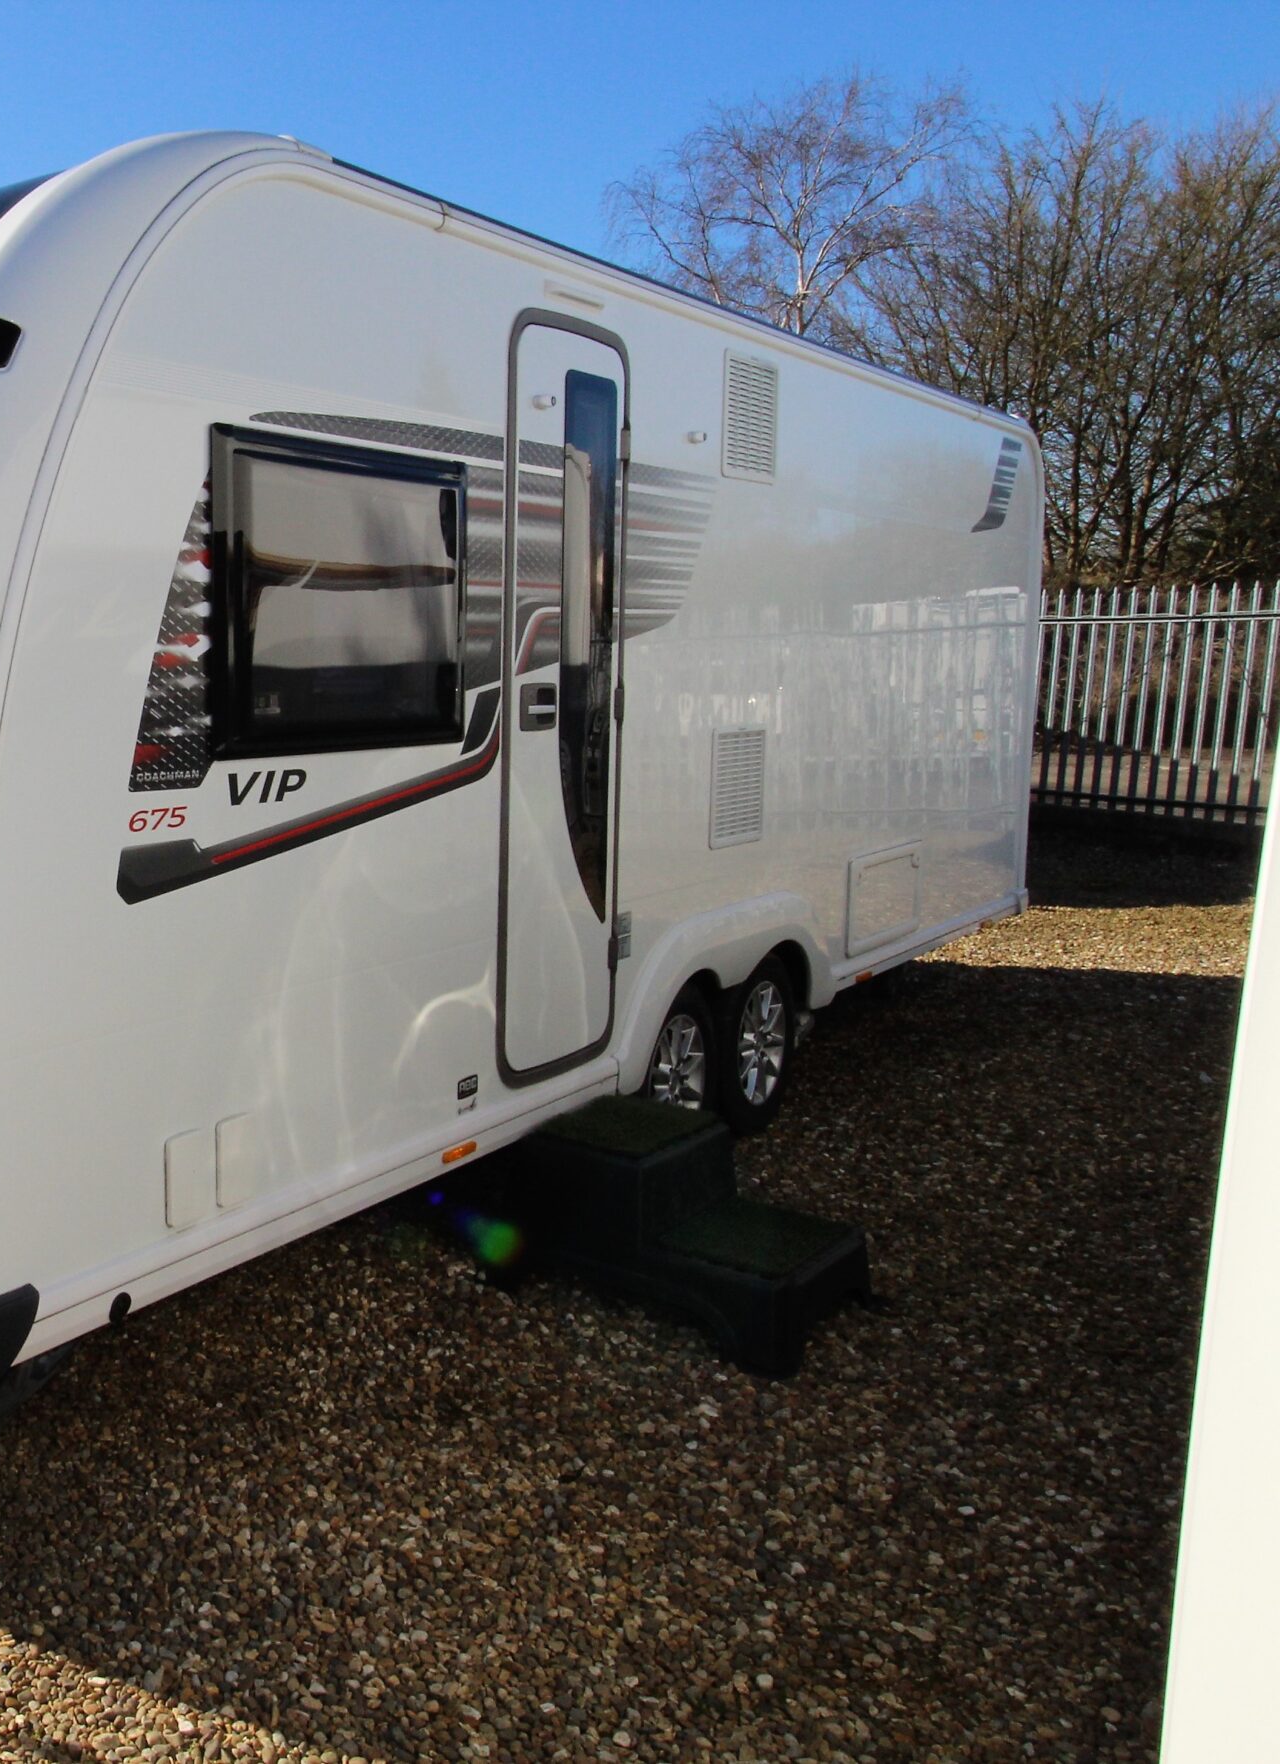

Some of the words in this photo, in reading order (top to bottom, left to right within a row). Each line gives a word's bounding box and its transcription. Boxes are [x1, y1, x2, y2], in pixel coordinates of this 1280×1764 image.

[136, 769, 200, 782] COACHMAN
[227, 768, 307, 806] VIP
[128, 806, 188, 832] 675
